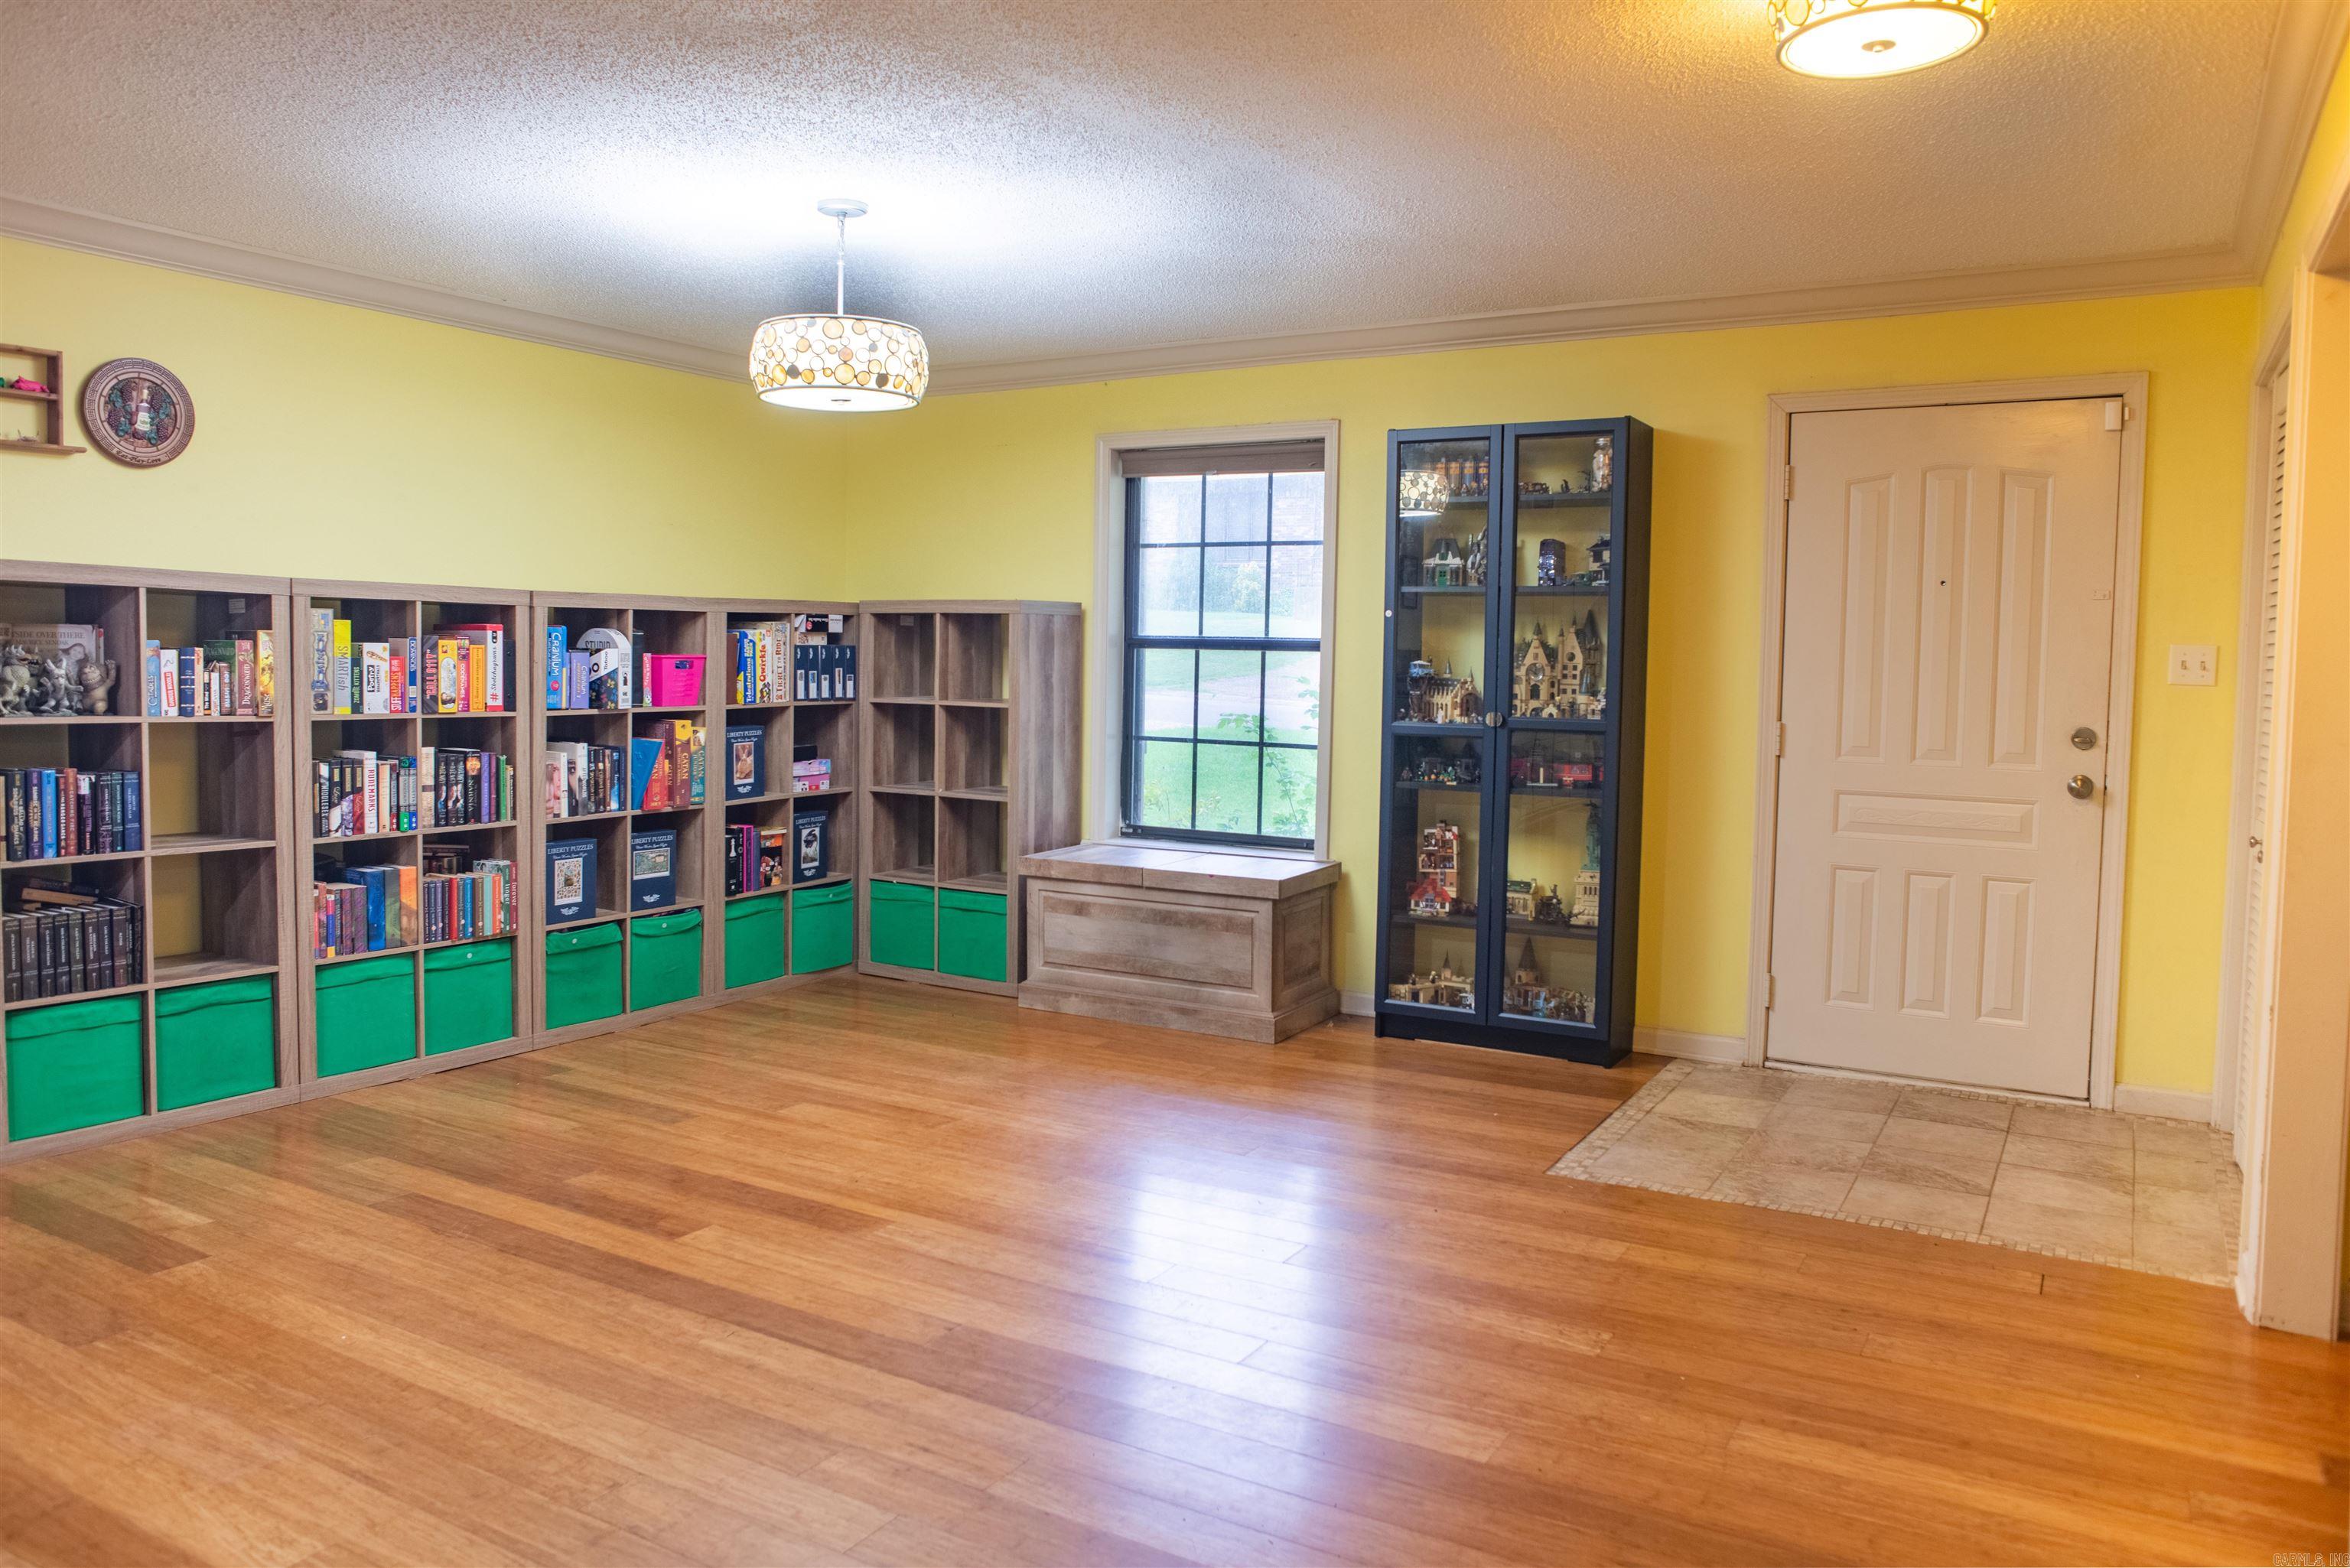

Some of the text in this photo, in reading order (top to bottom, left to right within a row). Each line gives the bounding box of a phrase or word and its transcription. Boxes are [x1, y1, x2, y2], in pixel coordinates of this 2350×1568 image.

[337, 646, 349, 691] SMARTish
[242, 663, 251, 705] DRAGONWOOD
[391, 672, 399, 697] HAPPENS
[391, 697, 402, 711] STUFF
[570, 844, 594, 852] PUZZLES
